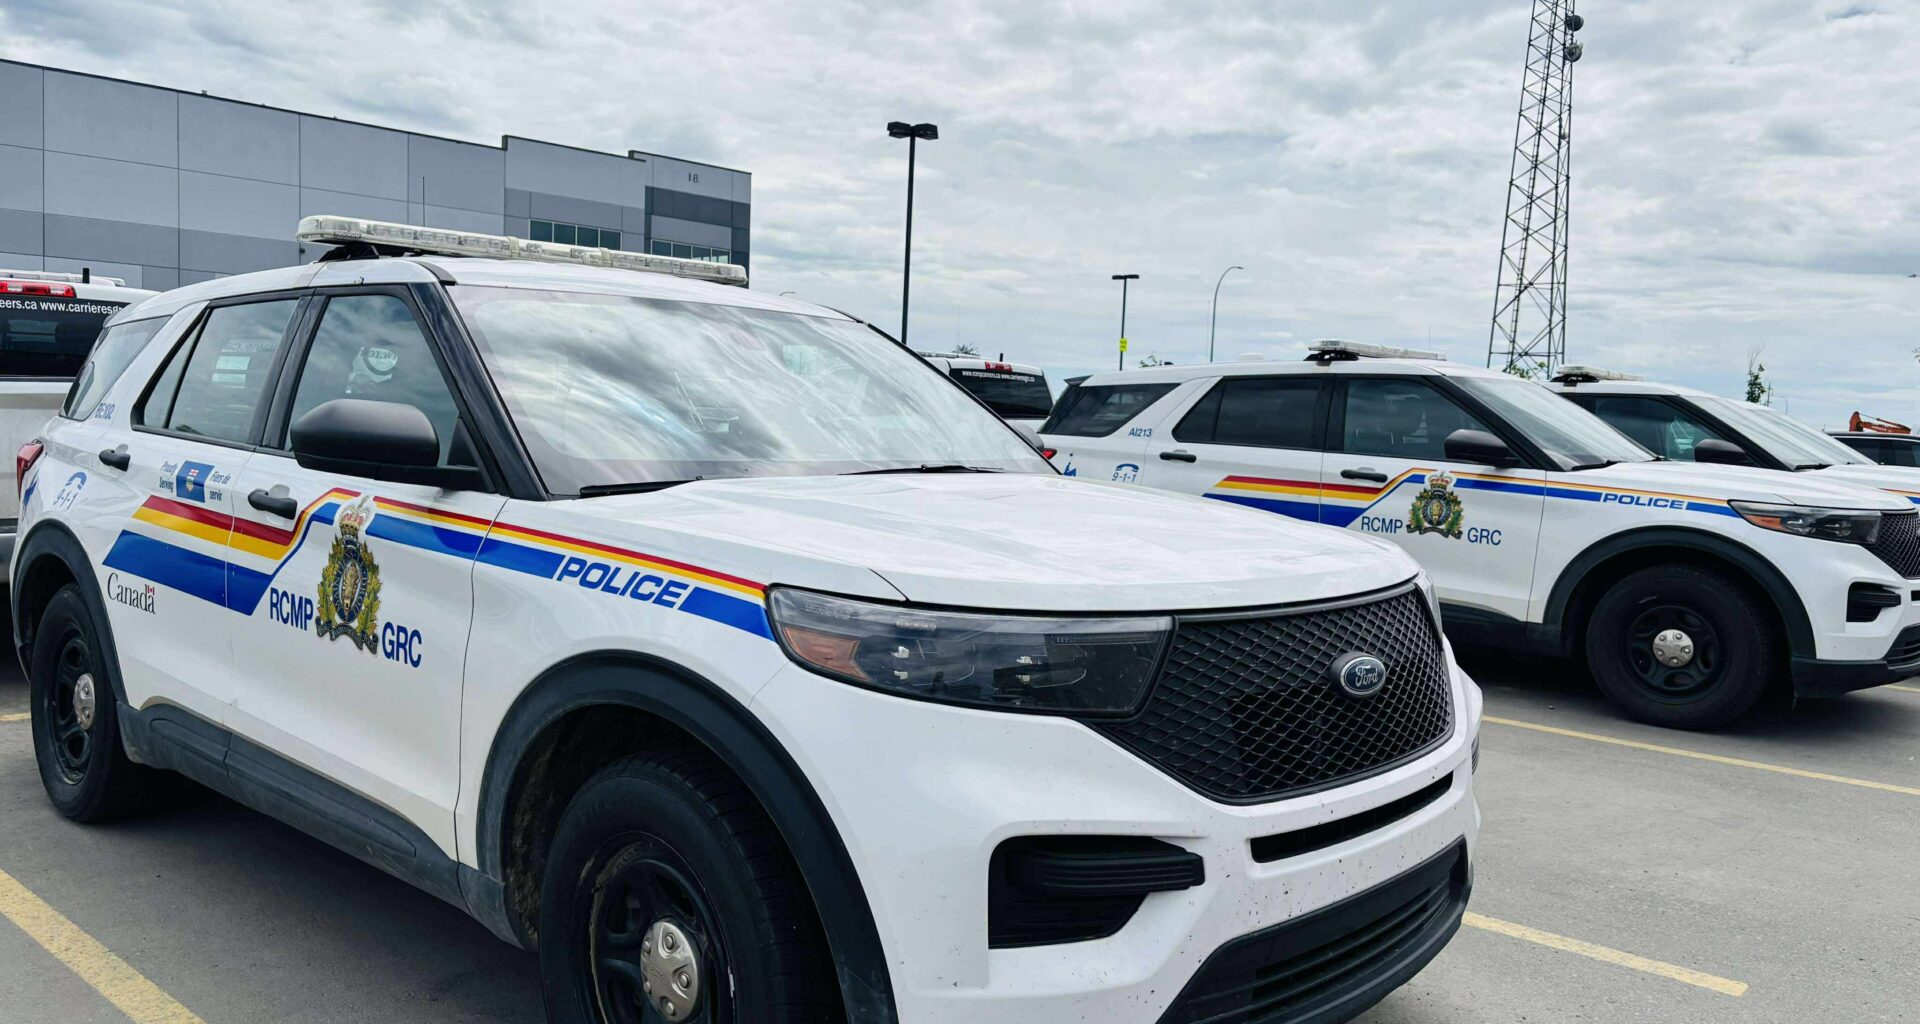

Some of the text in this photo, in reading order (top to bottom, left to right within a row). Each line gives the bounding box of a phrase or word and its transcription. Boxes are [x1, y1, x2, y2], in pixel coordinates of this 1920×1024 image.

[688, 172, 699, 183] 18
[1112, 471, 1137, 482] 9-1-1
[1603, 493, 1685, 509] POLICE
[1361, 516, 1403, 534] RCMP
[1467, 527, 1502, 546] GRC
[556, 556, 690, 608] POLICE
[107, 572, 156, 614] Canada
[270, 587, 314, 631] RCMP
[382, 621, 422, 668] GRC
[1355, 664, 1379, 687] Ford
